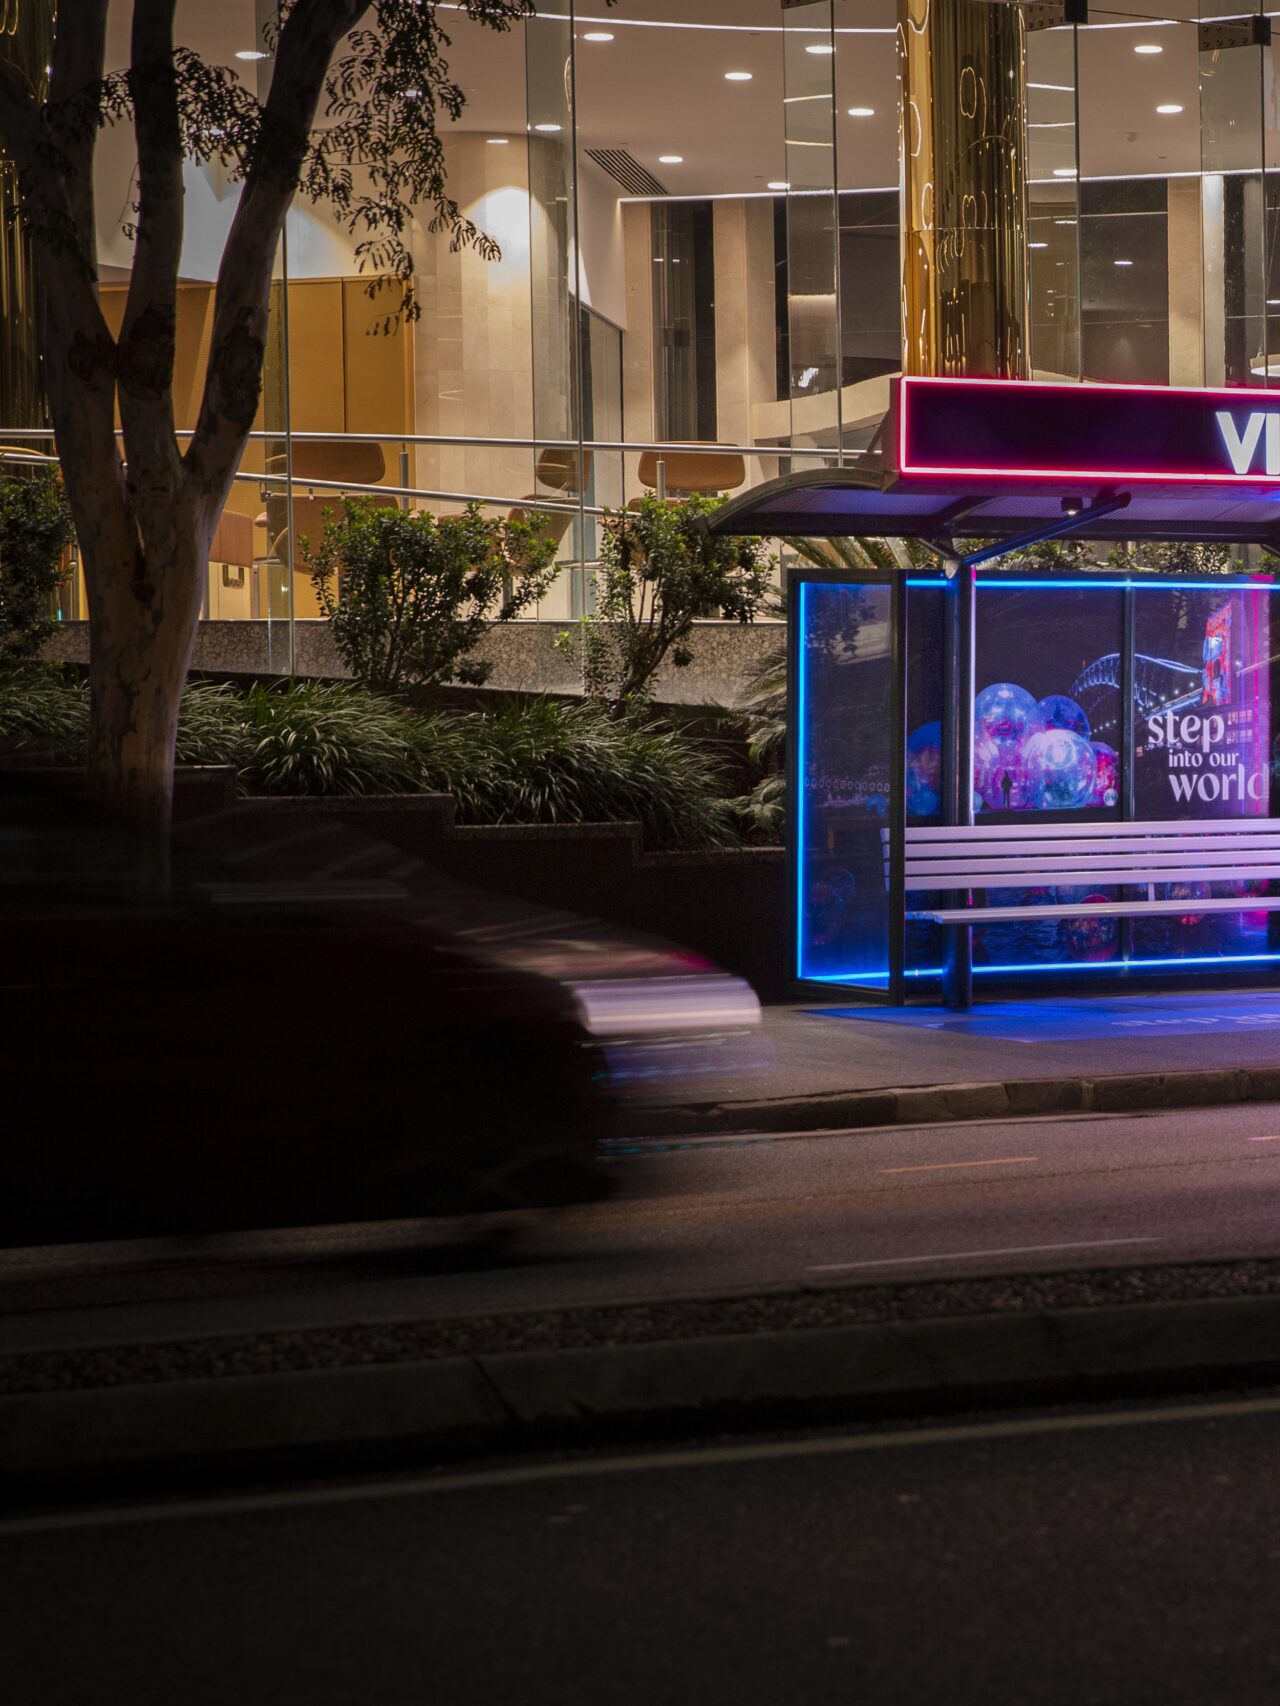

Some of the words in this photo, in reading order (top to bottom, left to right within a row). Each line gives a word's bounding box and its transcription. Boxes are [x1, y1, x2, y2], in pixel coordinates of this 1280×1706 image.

[1148, 710, 1225, 753] step
[1168, 749, 1203, 767] into
[1209, 751, 1240, 767] our
[1169, 763, 1270, 803] world
